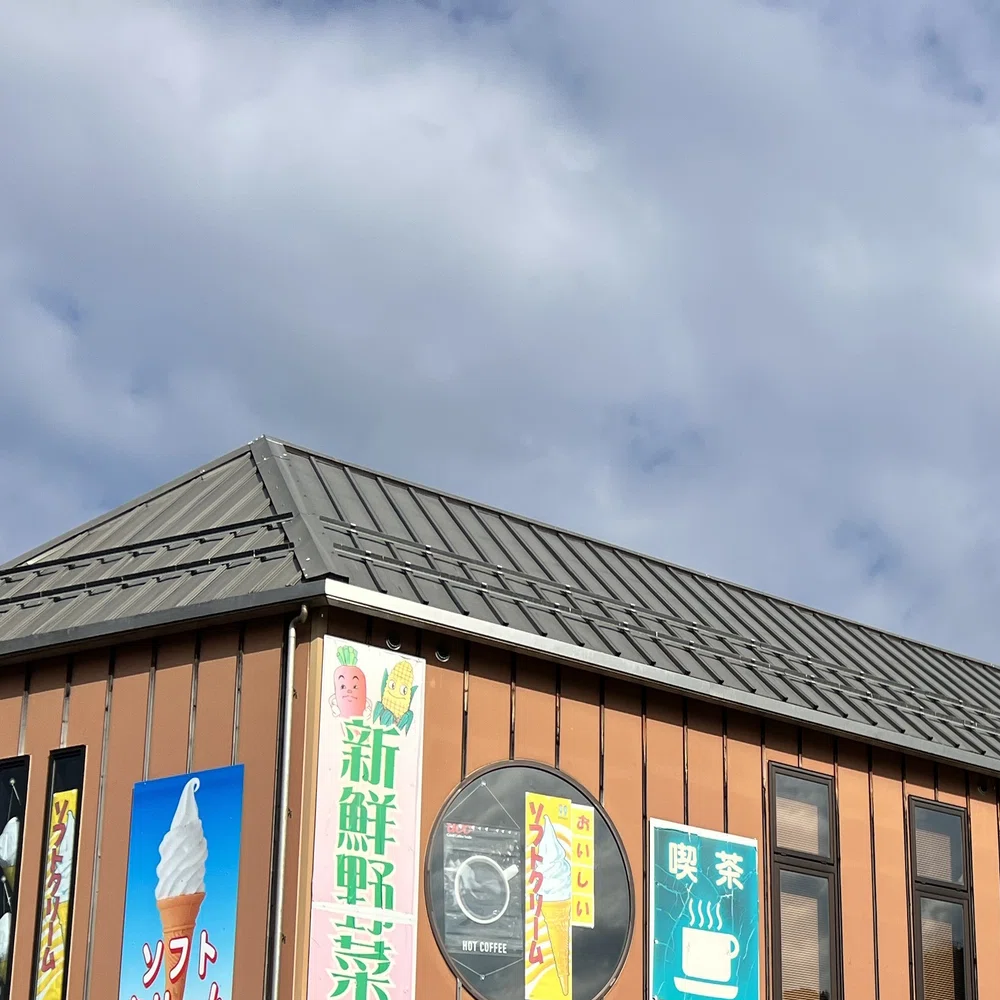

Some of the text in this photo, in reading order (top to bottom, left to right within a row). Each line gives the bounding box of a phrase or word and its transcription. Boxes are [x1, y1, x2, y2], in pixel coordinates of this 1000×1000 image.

[40, 799, 69, 971] ソフトクリーム
[529, 801, 544, 965] ソフトクリーム
[576, 814, 590, 917] おいしい
[667, 841, 745, 891] 喫茶
[142, 929, 218, 989] ソフト
[462, 940, 507, 954] HOT COFFEE
